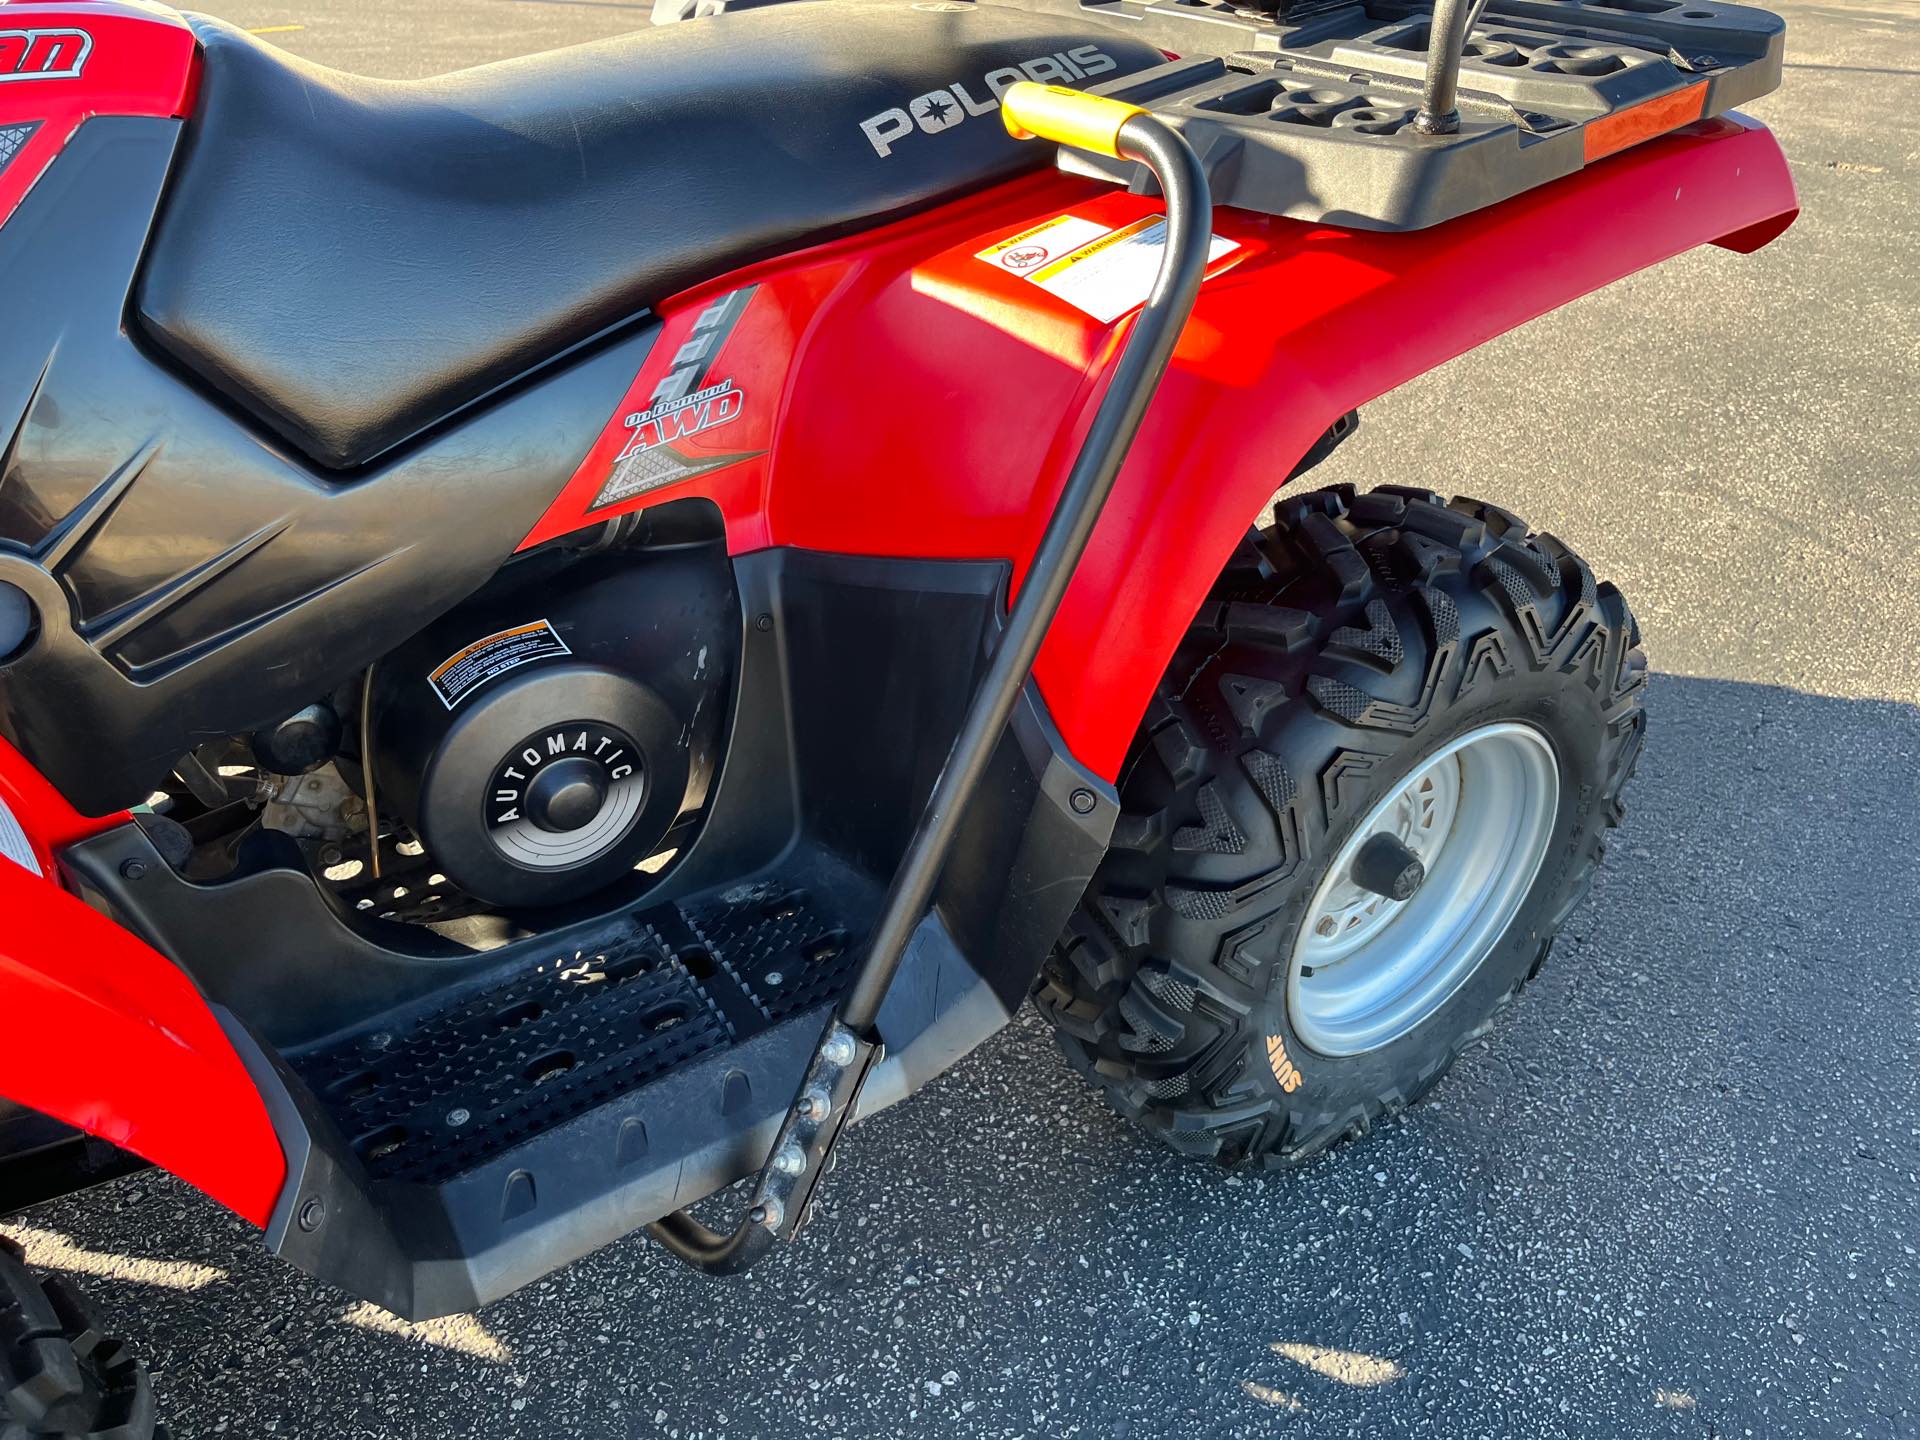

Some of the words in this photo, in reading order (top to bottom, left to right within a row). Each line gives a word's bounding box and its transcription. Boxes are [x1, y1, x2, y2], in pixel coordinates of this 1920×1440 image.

[859, 44, 1117, 158] POLARIS
[1009, 222, 1056, 246] WARNING
[1082, 232, 1130, 256] WARNING
[613, 389, 744, 463] AWD
[625, 411, 651, 427] On
[653, 380, 731, 417] Demand
[473, 633, 510, 650] WARNING
[487, 666, 500, 676] NO
[501, 657, 521, 670] STEP
[496, 731, 633, 822] AUTOMATIC
[1266, 1034, 1303, 1093] SUNF
